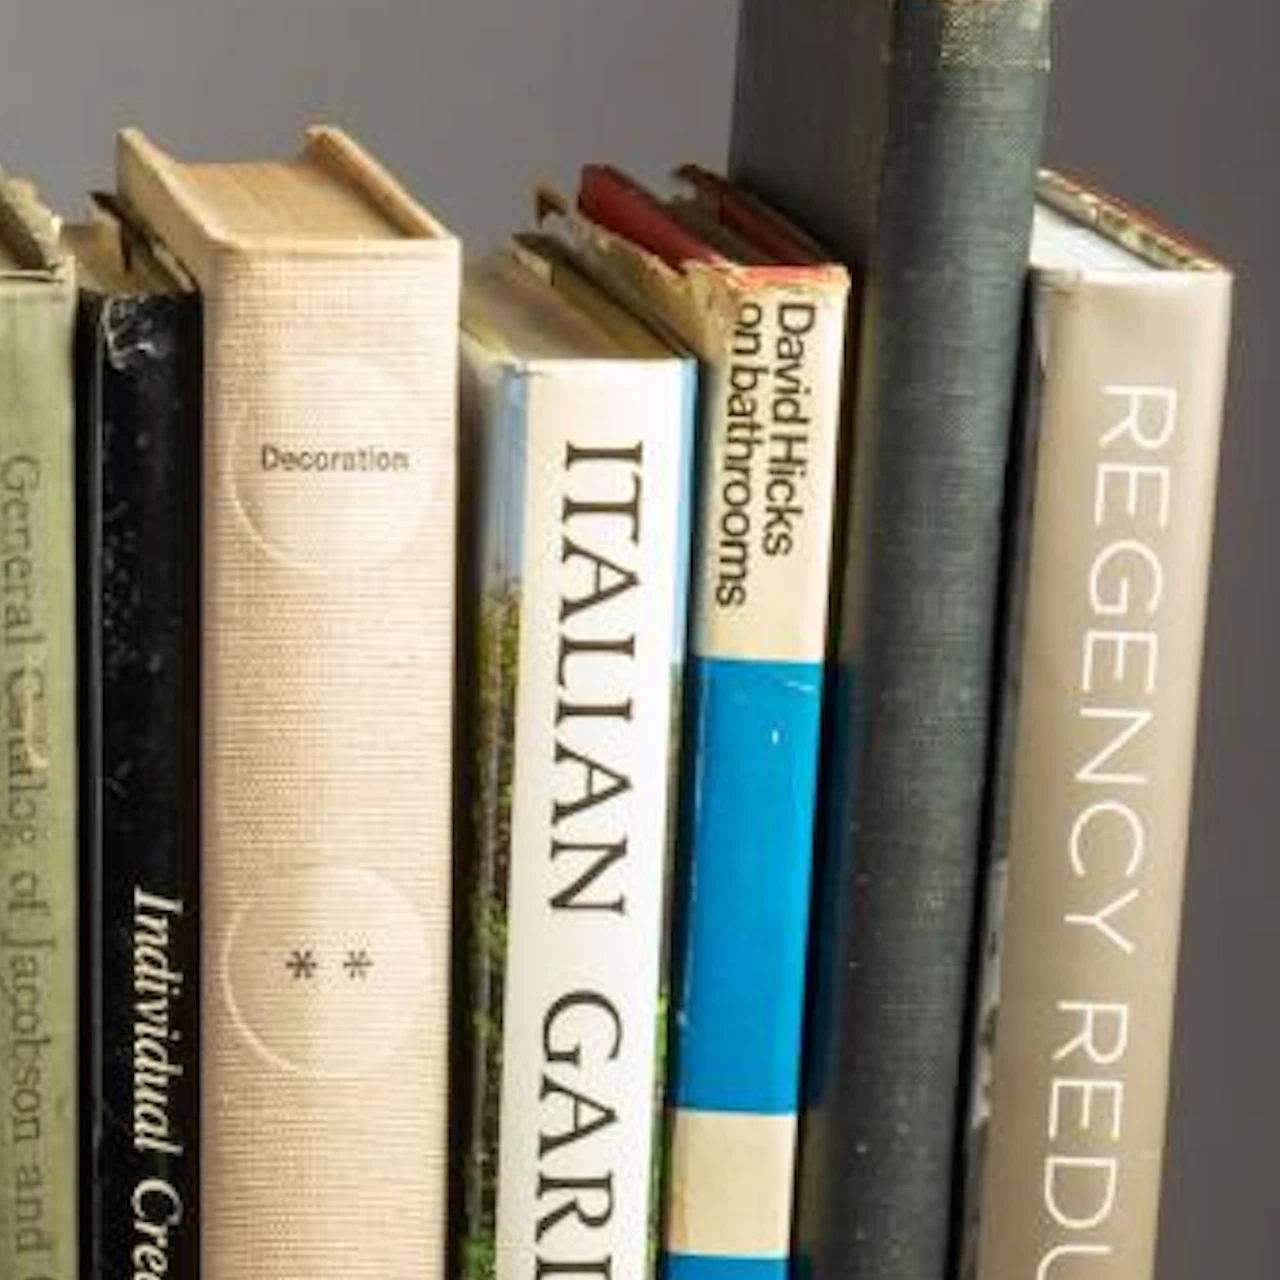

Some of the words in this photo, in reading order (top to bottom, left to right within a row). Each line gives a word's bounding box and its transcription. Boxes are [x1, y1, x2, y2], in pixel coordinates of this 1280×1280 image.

[732, 301, 763, 357] on
[771, 302, 816, 423] David
[260, 443, 410, 472] Decoration
[716, 365, 766, 608] bathrooms
[761, 429, 809, 557] Hicks
[1, 454, 46, 644] General
[549, 441, 645, 917] ITALIAN
[1064, 384, 1178, 955] REGENCY
[132, 885, 185, 1157] Individual
[14, 1163, 52, 1252] and
